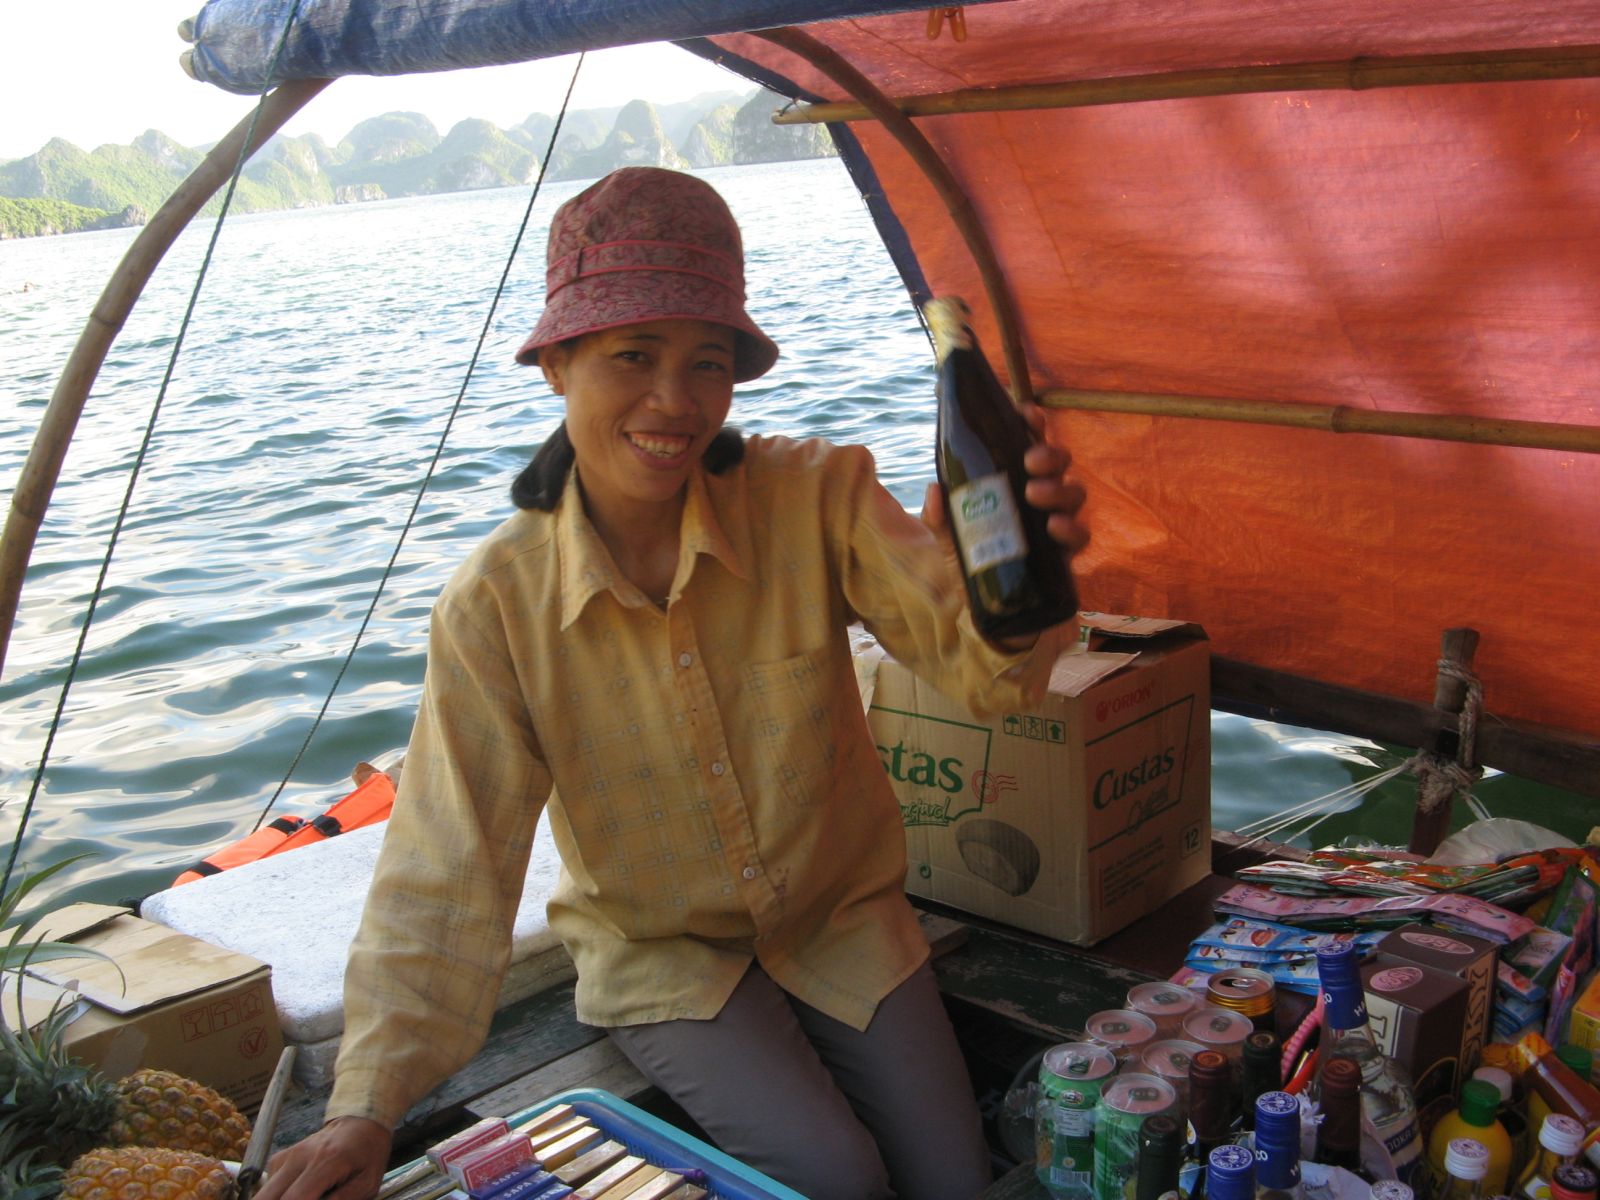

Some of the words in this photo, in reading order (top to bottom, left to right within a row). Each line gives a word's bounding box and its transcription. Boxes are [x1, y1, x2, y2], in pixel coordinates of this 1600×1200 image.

[1111, 686, 1152, 713] ORION
[1093, 746, 1176, 810] Custas
[1185, 827, 1200, 852] 12
